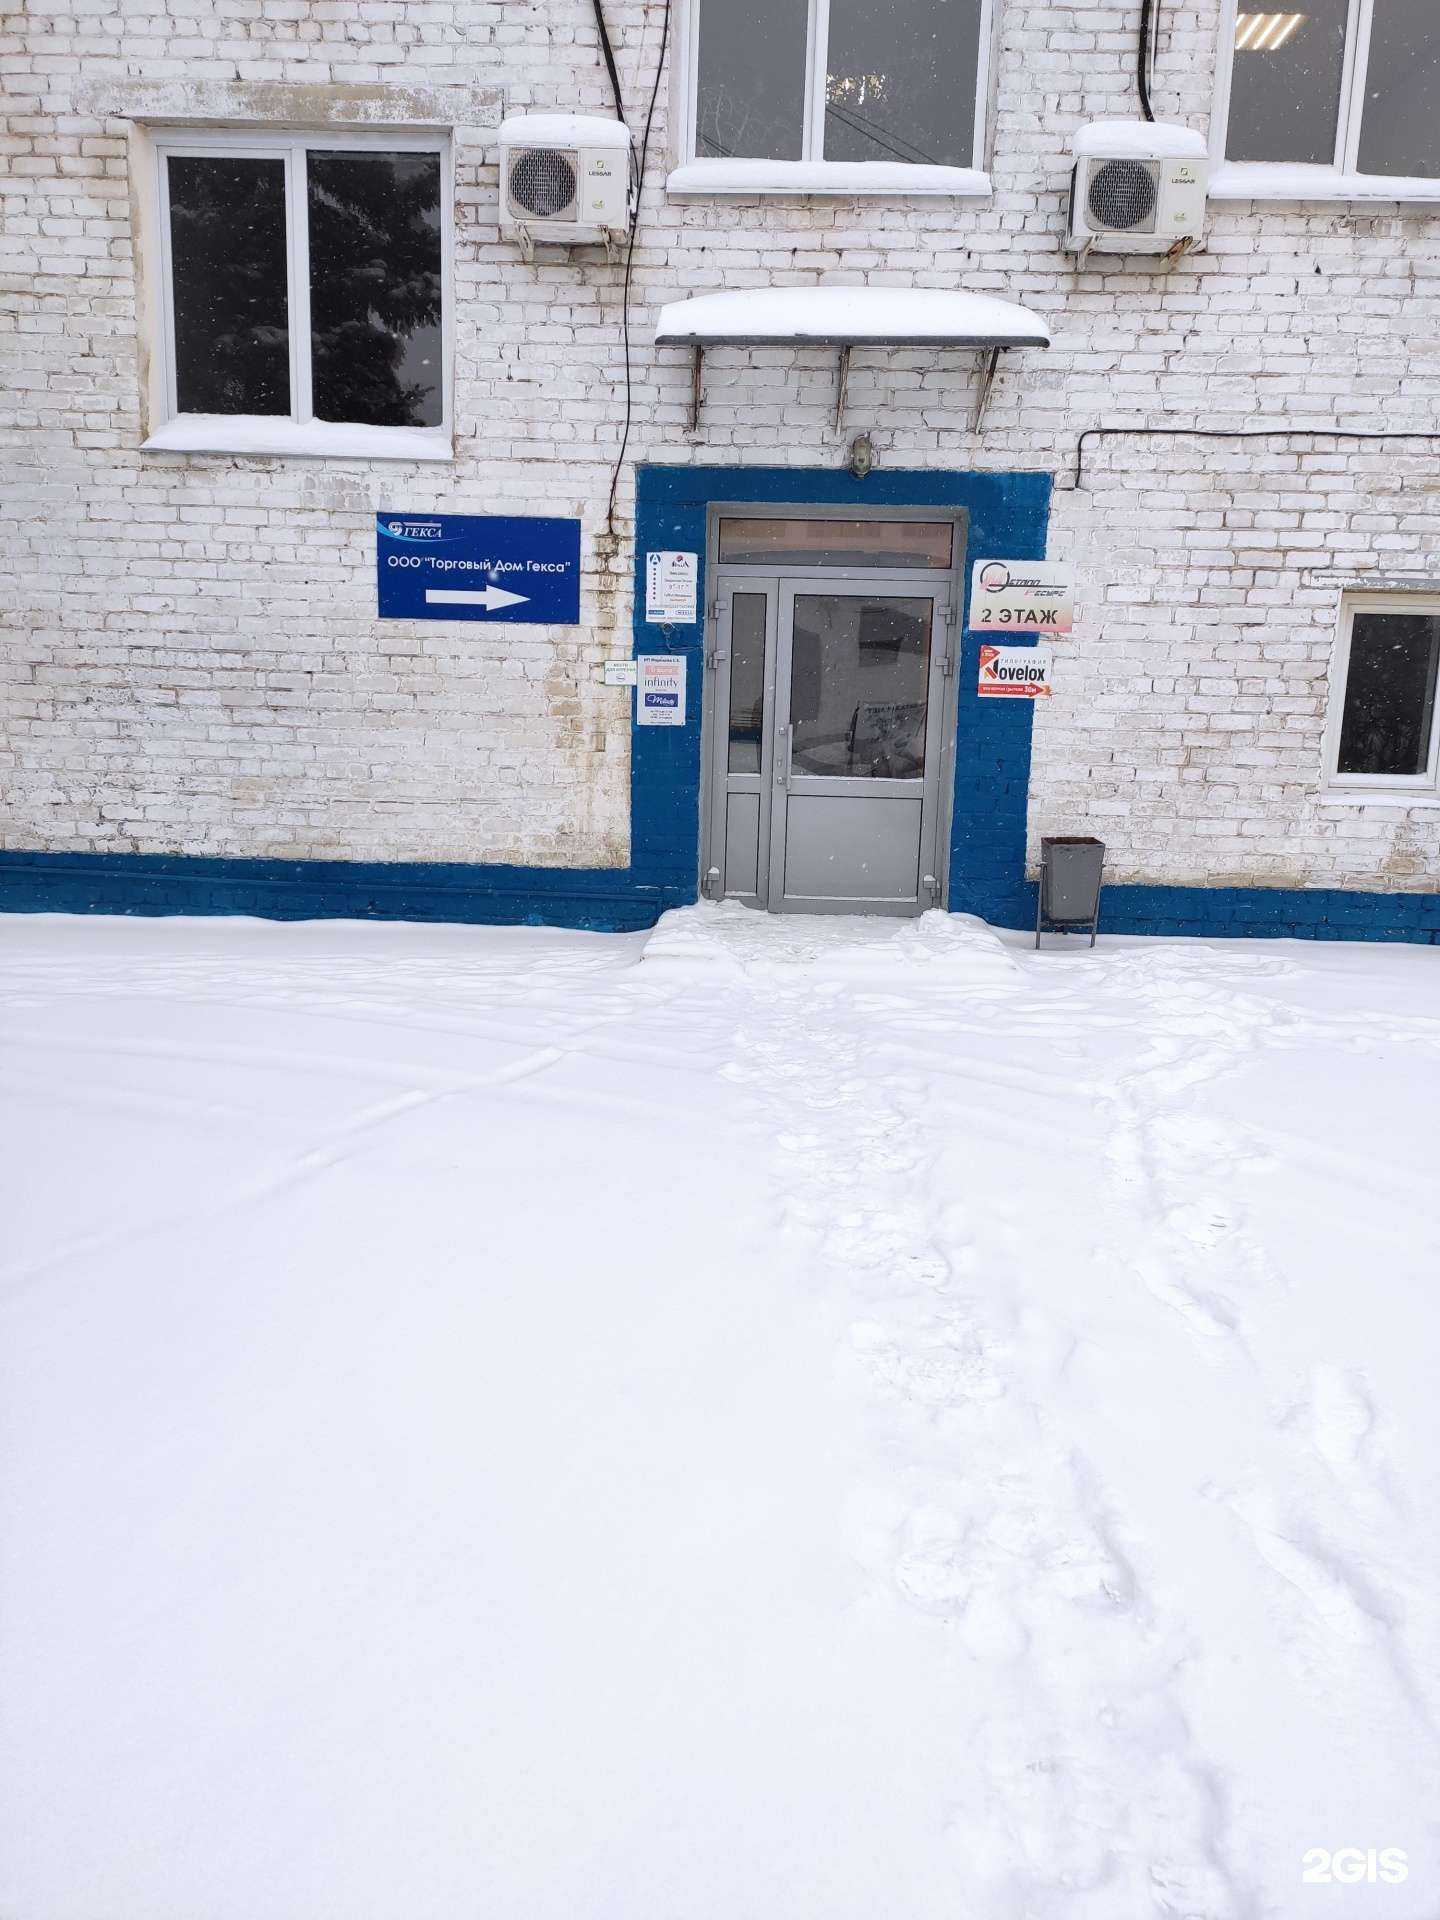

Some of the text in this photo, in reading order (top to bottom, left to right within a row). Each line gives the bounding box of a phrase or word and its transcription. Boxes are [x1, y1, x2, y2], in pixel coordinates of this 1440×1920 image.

[403, 527, 442, 538] ГЕКСА
[388, 555, 421, 568] ООО
[494, 560, 523, 572] Дом
[981, 608, 1059, 624] 2 ЭТАЖ
